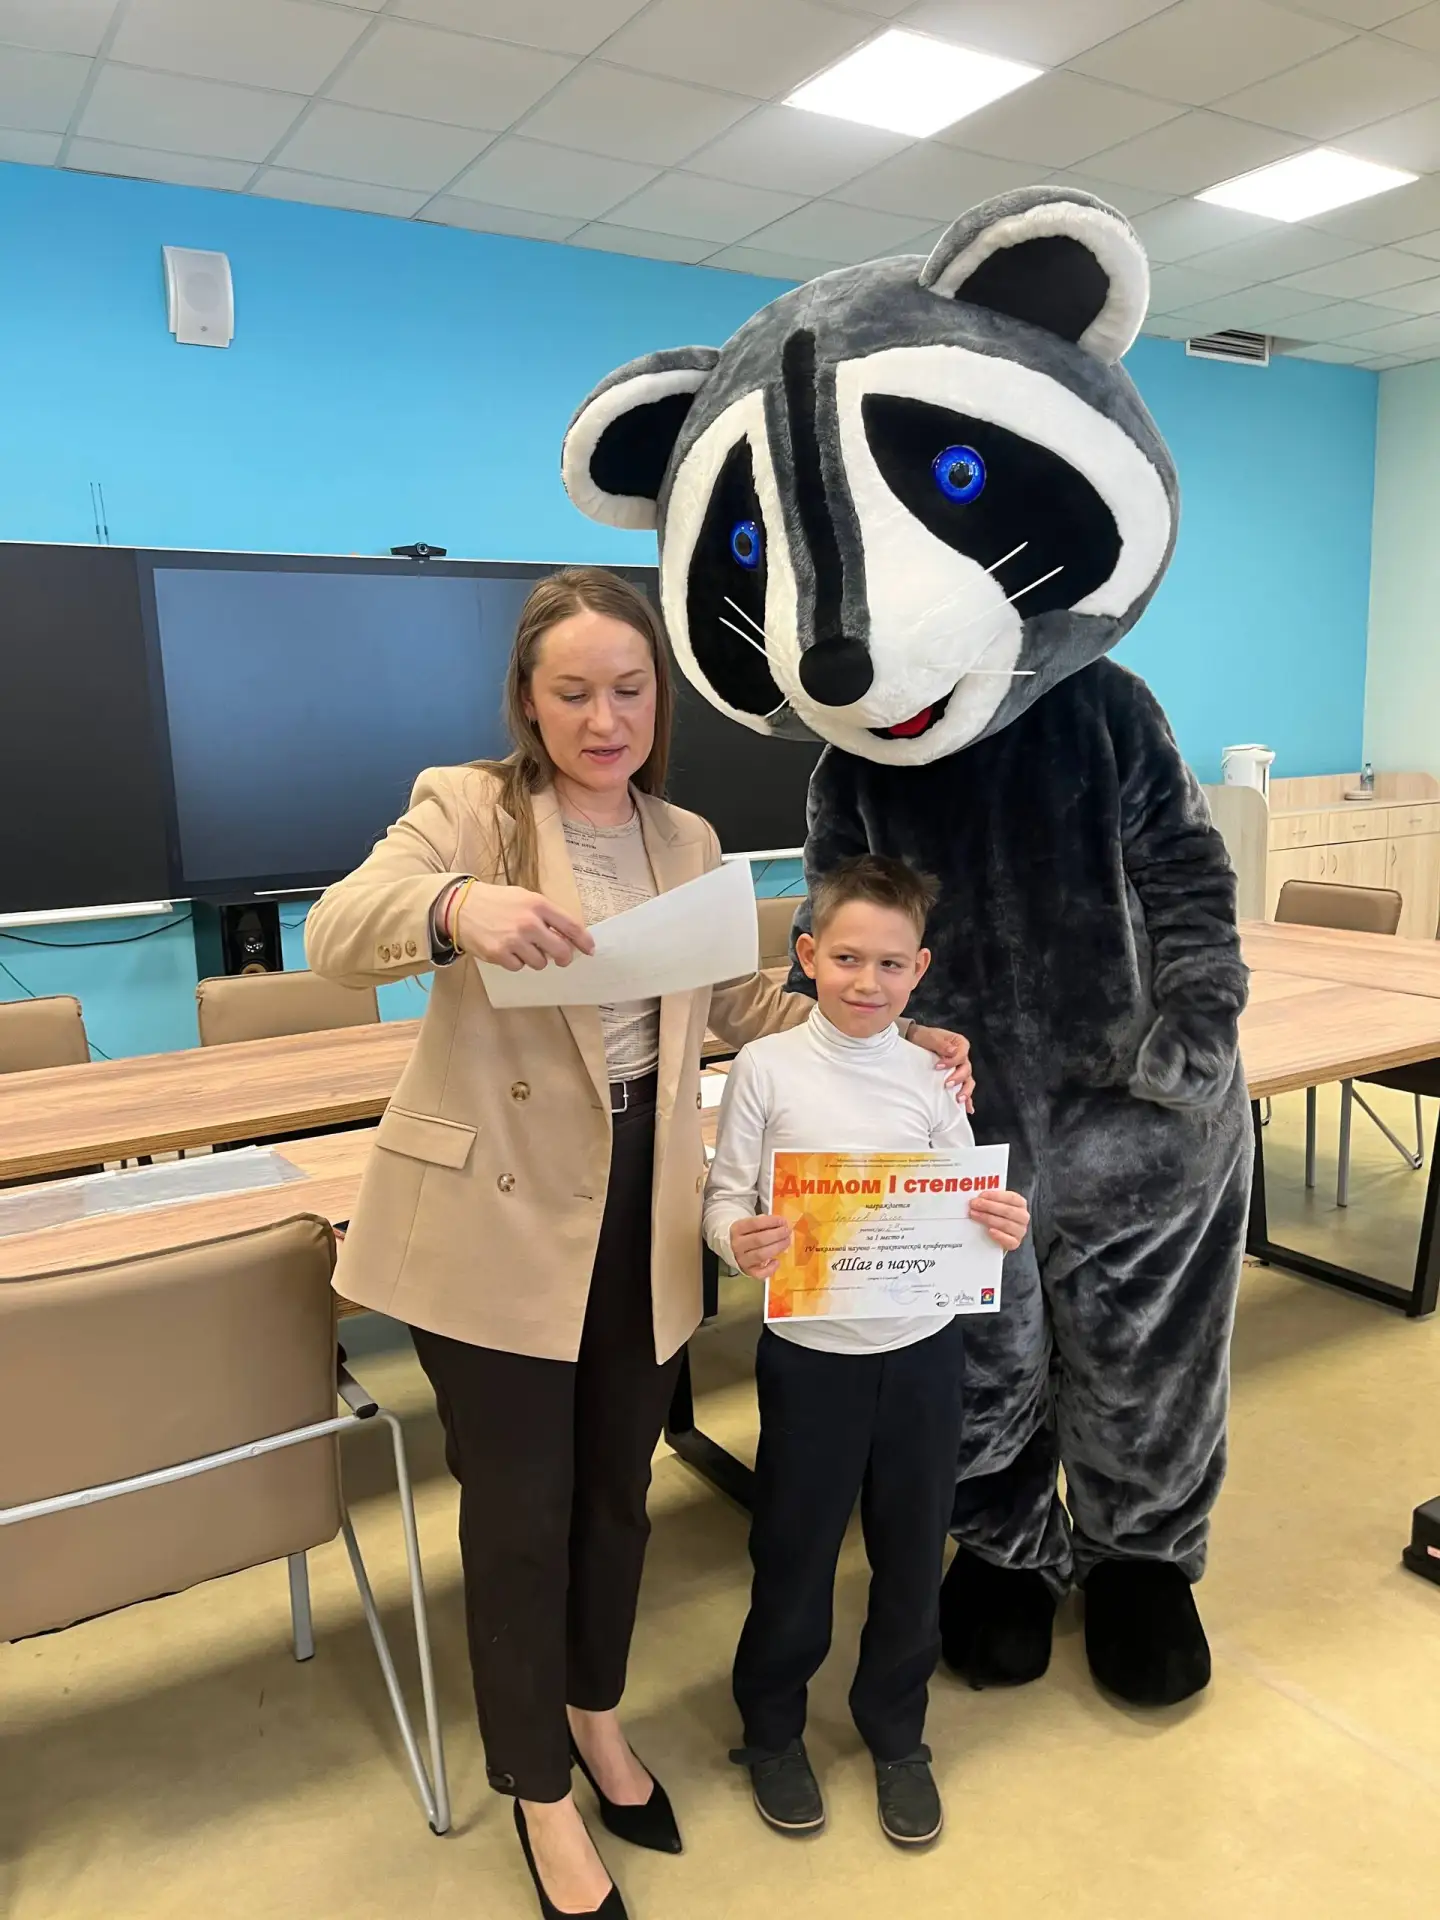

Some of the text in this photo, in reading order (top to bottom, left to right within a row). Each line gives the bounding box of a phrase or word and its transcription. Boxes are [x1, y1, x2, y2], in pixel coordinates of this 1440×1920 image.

[780, 1175, 880, 1198] Диплом
[904, 1174, 999, 1194] степени
[848, 1245, 870, 1254] научно
[877, 1244, 922, 1253] практической
[923, 1242, 963, 1252] конференции
[831, 1257, 936, 1274] «Шаг в науку»
